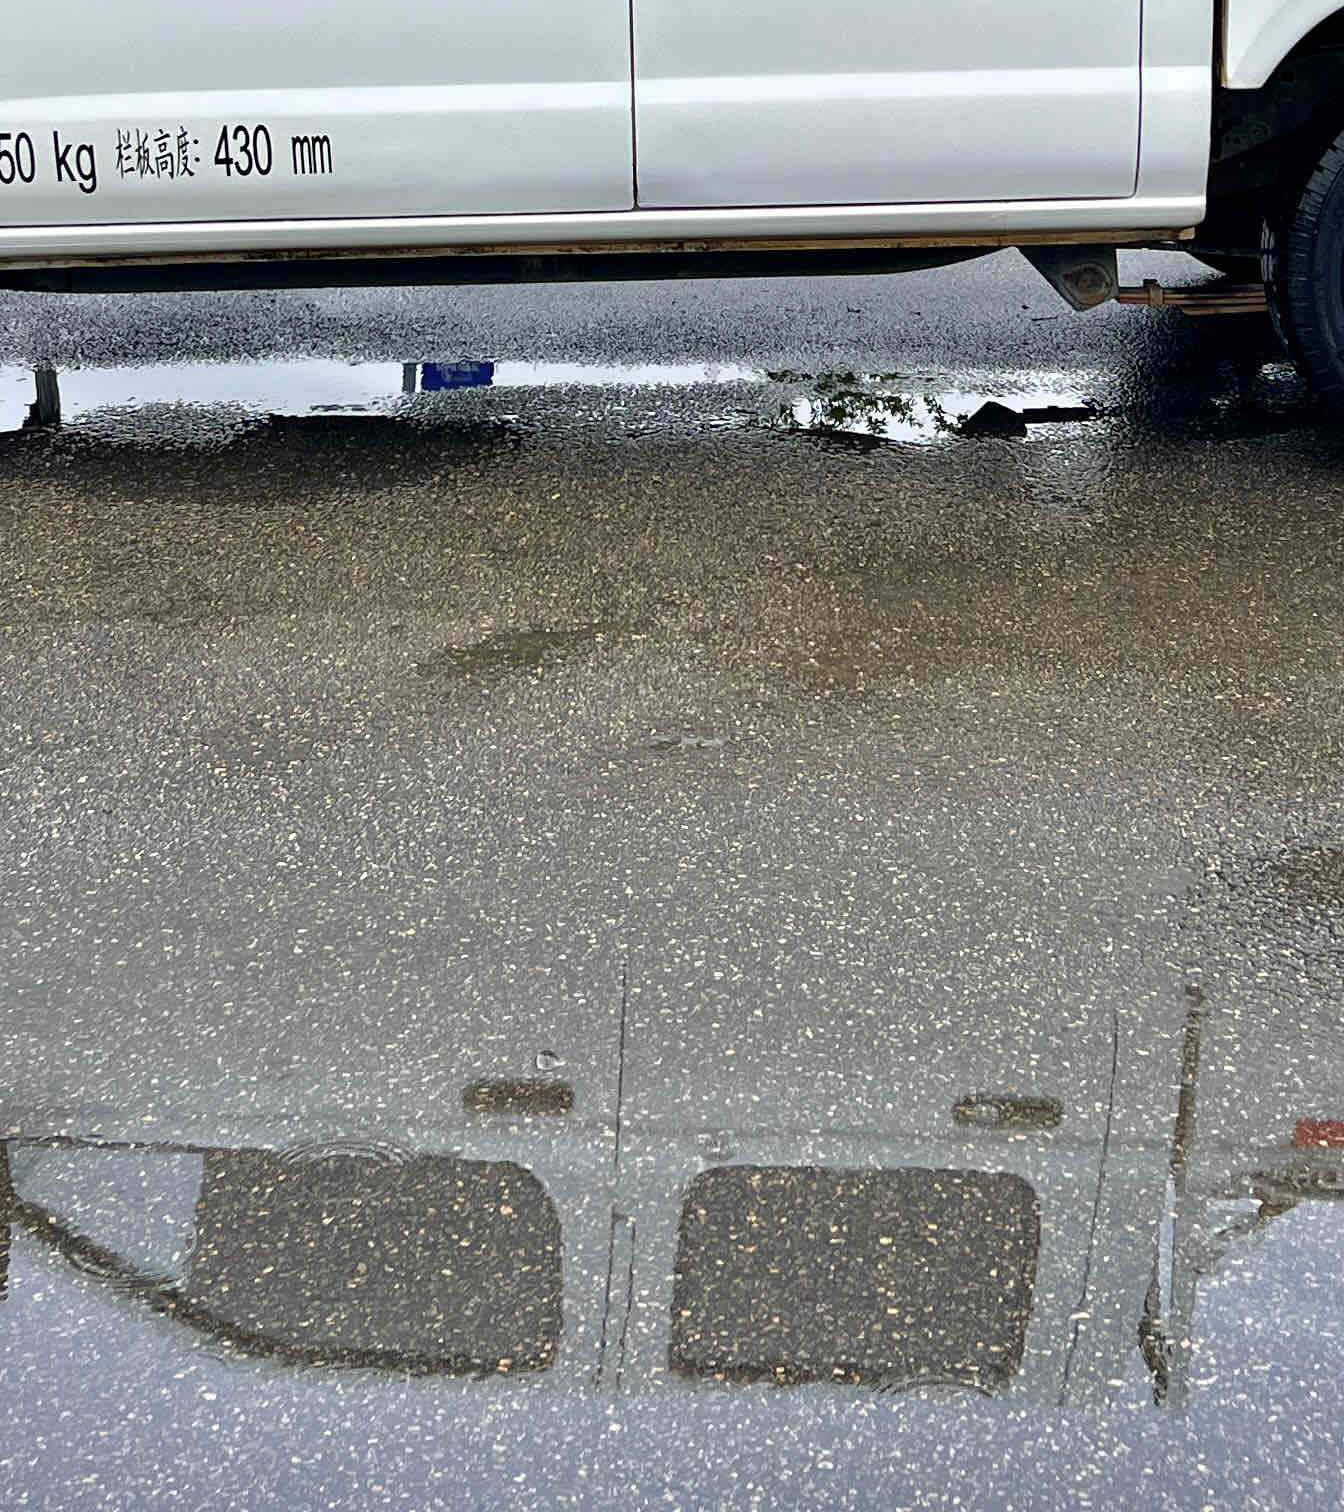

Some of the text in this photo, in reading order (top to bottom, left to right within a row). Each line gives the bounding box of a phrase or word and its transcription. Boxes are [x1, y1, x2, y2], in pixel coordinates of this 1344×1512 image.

[54, 129, 97, 194] kg
[214, 124, 273, 177] 430
[291, 133, 334, 176] mm
